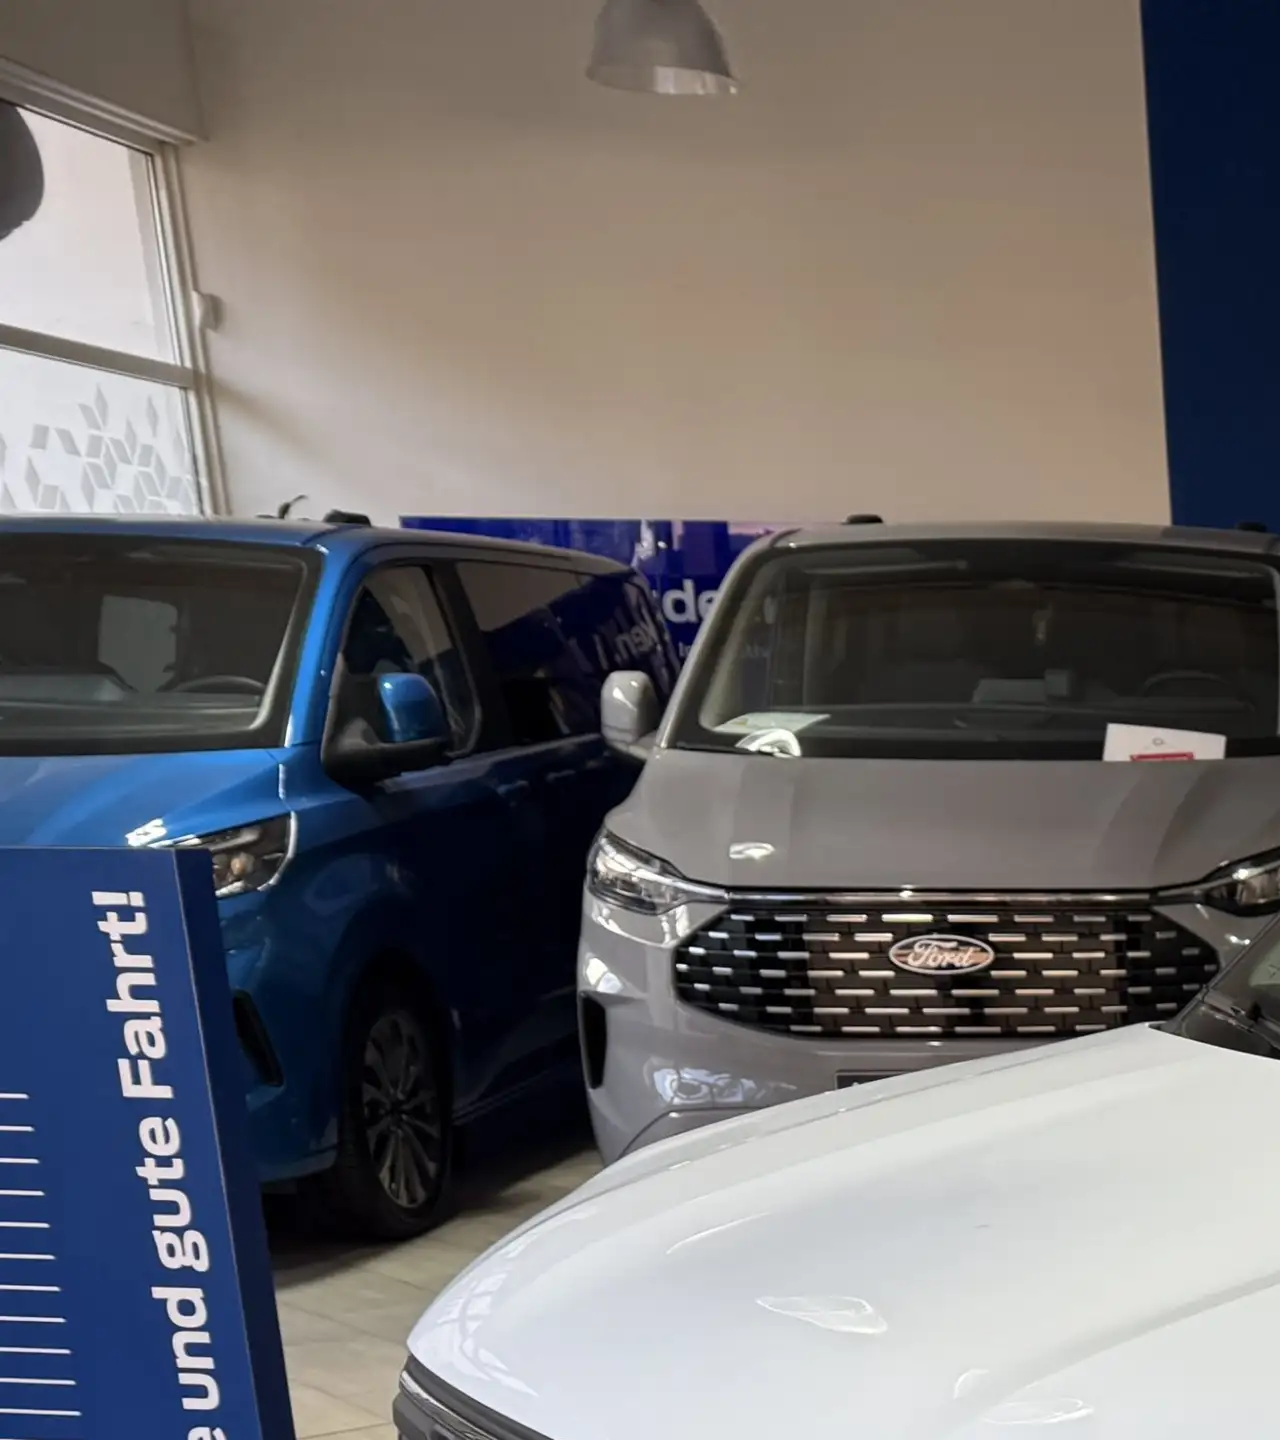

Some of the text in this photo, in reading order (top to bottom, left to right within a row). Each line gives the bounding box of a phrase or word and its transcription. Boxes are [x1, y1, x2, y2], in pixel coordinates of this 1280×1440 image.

[91, 891, 174, 1098] Fahrt!
[135, 1116, 210, 1272] gute
[151, 1286, 220, 1411] und
